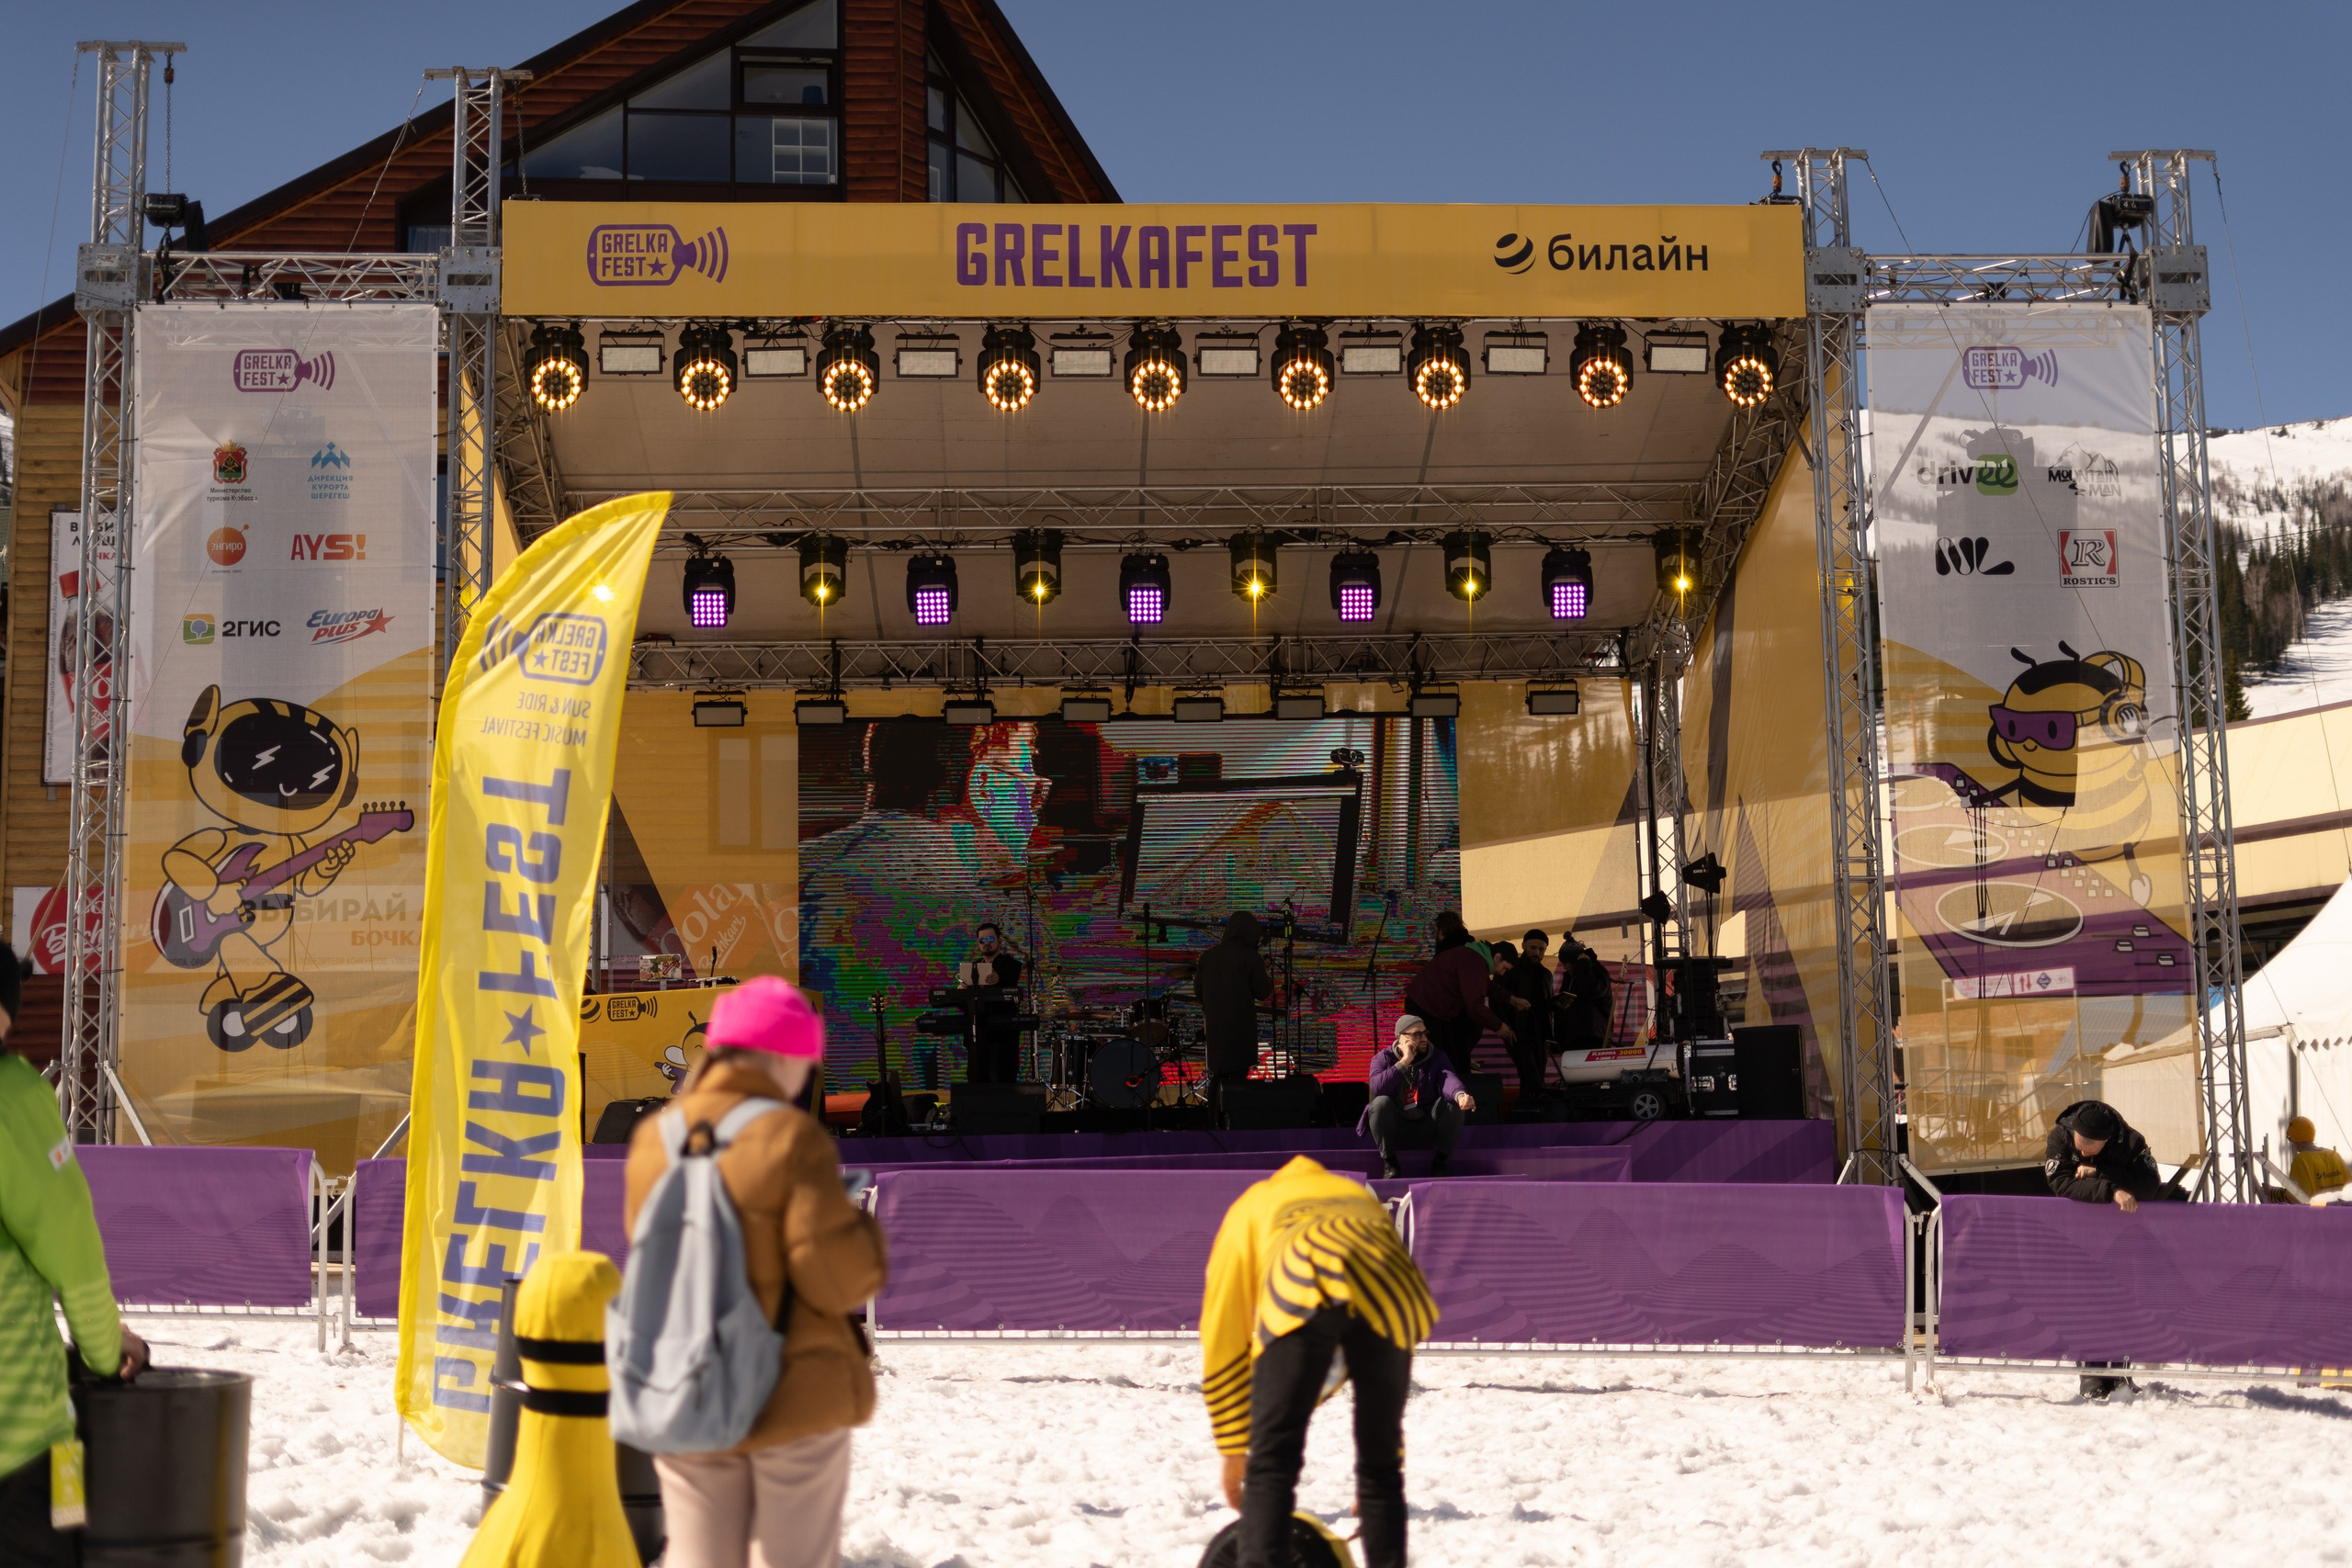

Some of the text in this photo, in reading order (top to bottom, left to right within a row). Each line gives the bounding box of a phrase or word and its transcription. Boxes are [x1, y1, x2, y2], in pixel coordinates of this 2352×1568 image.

[601, 232, 669, 254] GRELKA
[956, 223, 1317, 288] GRELKAFEST
[1547, 232, 1709, 272] билайн
[601, 256, 647, 277] FEST
[243, 355, 292, 370] GRELKA
[1972, 352, 2018, 367] GRELKA
[243, 371, 276, 386] FEST
[1972, 368, 2003, 383] FEST
[307, 475, 354, 483] ДИРЕКЦИЯ
[1917, 459, 2019, 488] drivee
[209, 487, 252, 495] Министерство
[206, 495, 231, 503] туризма
[210, 541, 243, 553] энгиро
[290, 534, 367, 561] AYS!
[2063, 577, 2117, 586] ROSTIC'S
[221, 620, 281, 637] 2ГИС
[351, 930, 421, 946] БОЧК
[611, 999, 637, 1010] GRELKA
[611, 1009, 629, 1019] FEST
